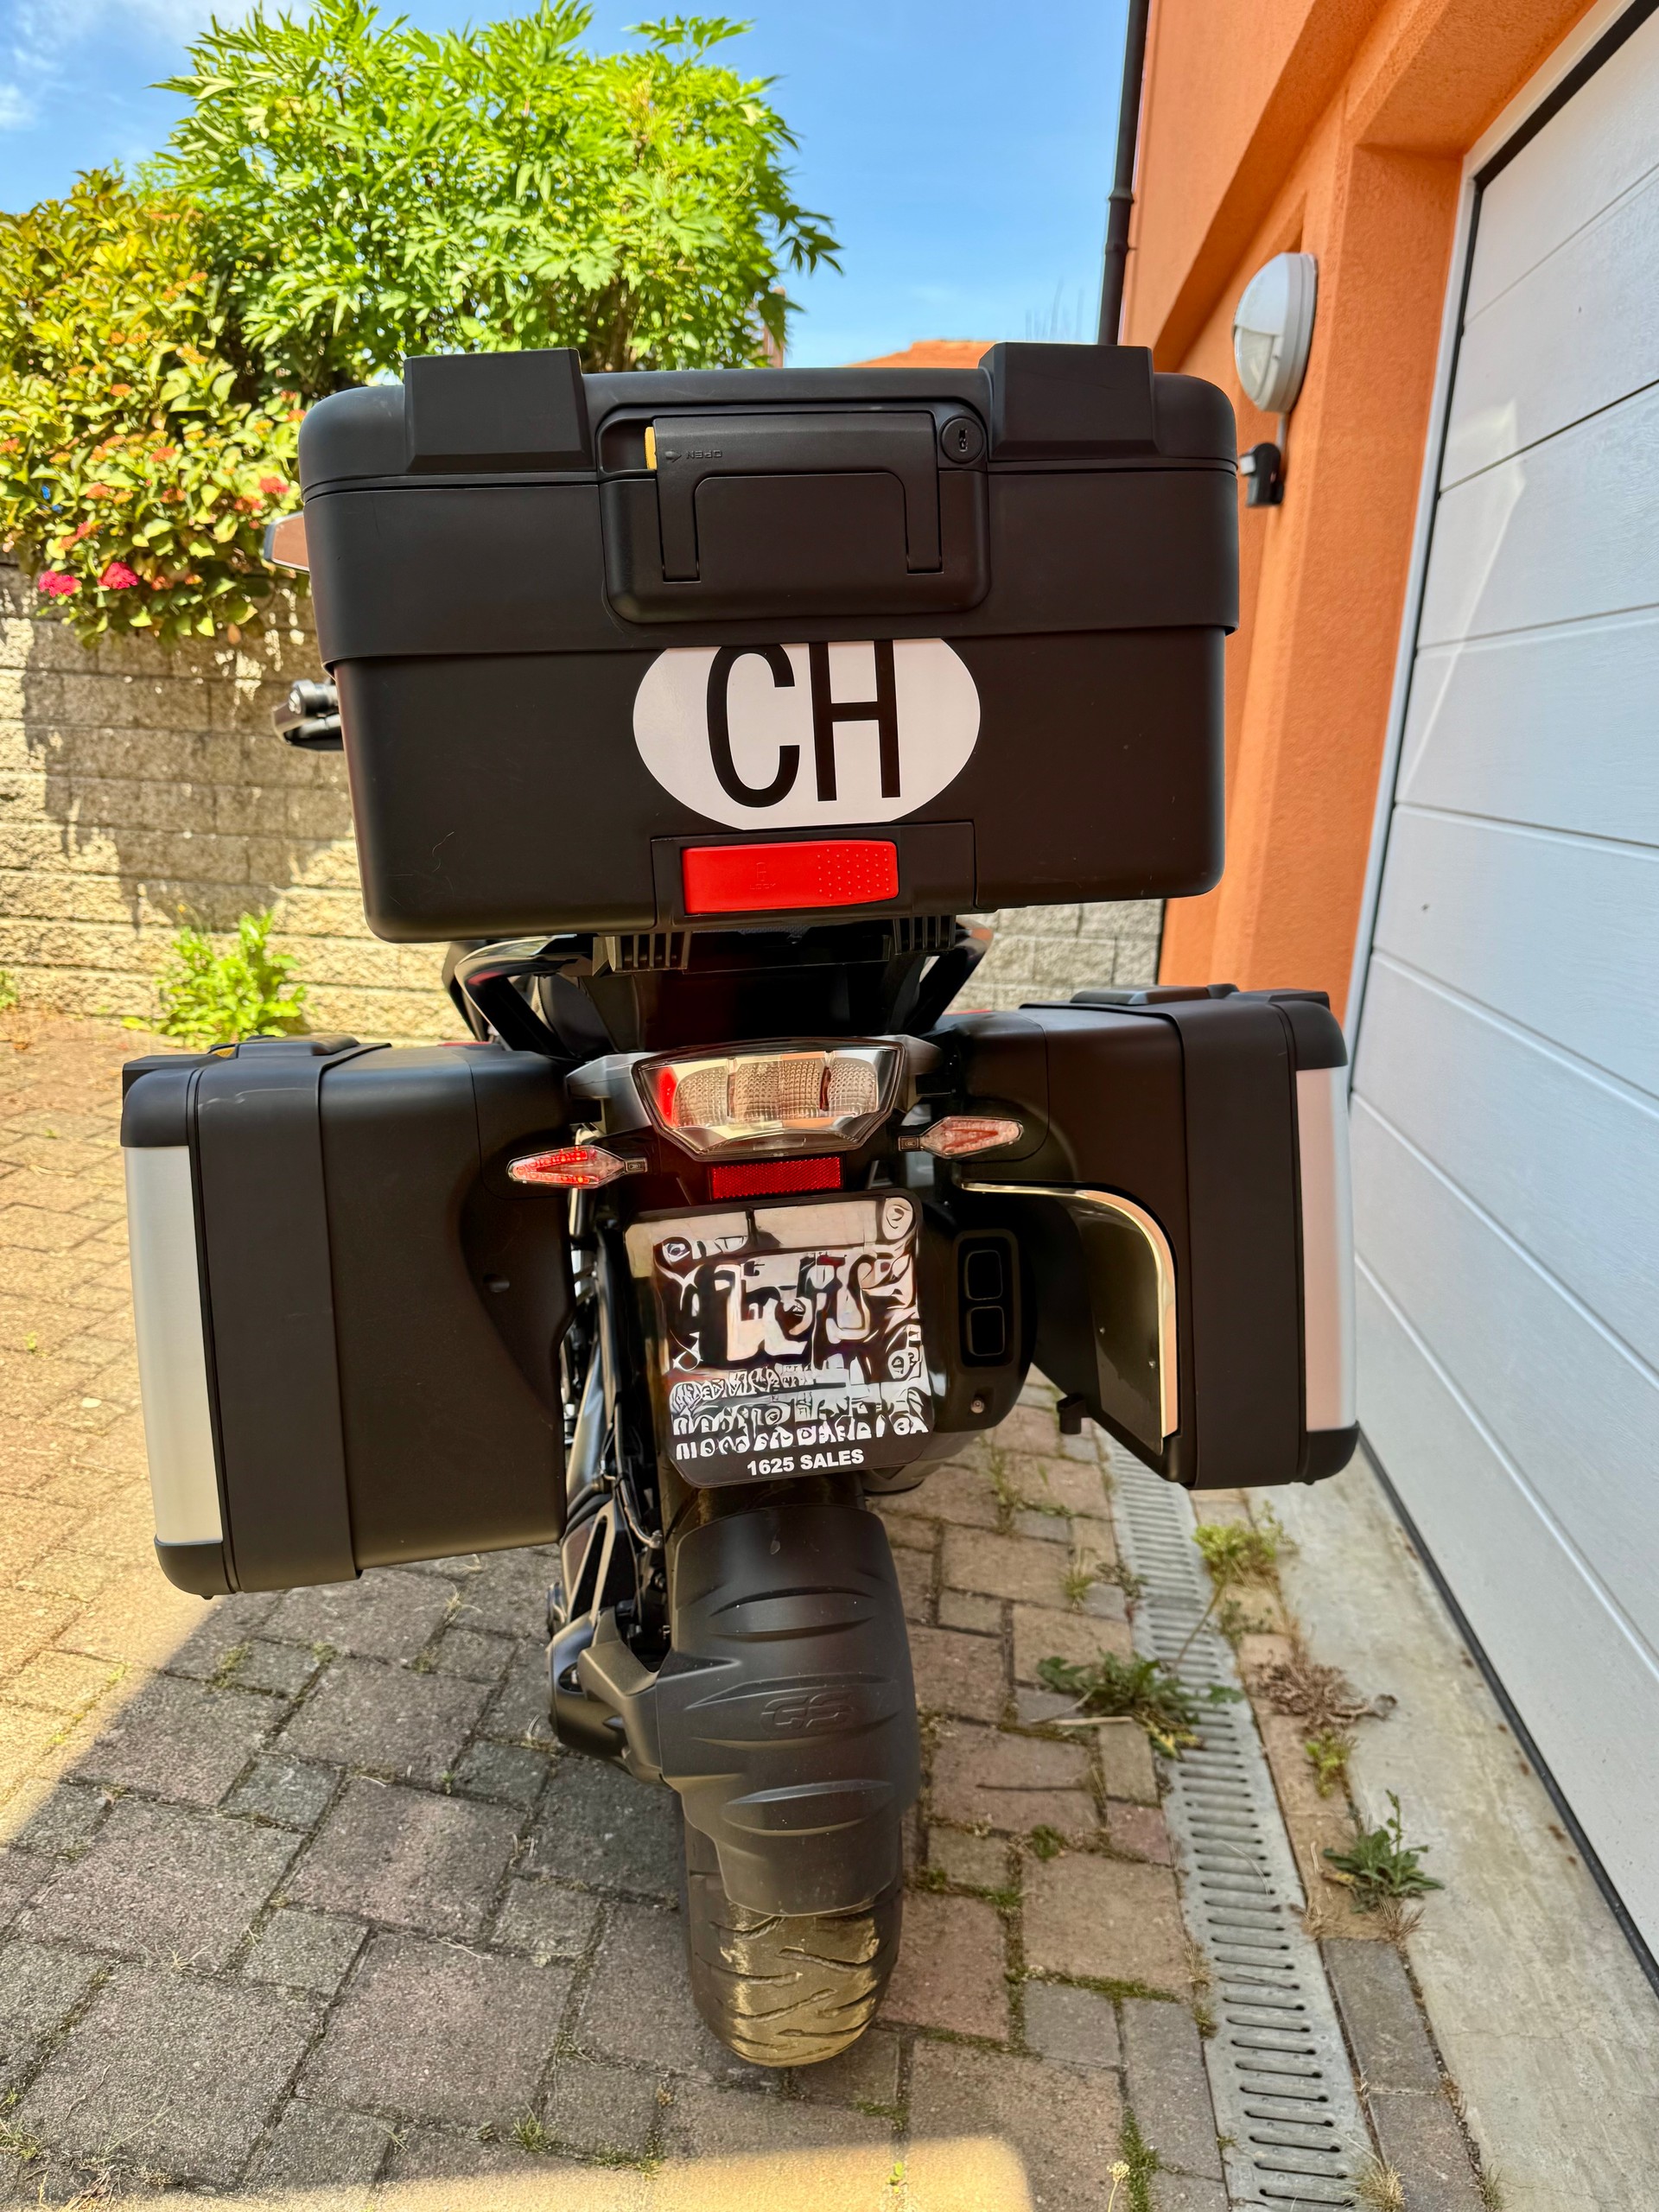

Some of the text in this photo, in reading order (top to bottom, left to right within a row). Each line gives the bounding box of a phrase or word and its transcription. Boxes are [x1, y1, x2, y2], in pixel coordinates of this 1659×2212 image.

[687, 449, 722, 459] OPEN
[706, 639, 900, 808] CH
[747, 1448, 865, 1476] 1625 SALES
[760, 1691, 855, 1732] GS
